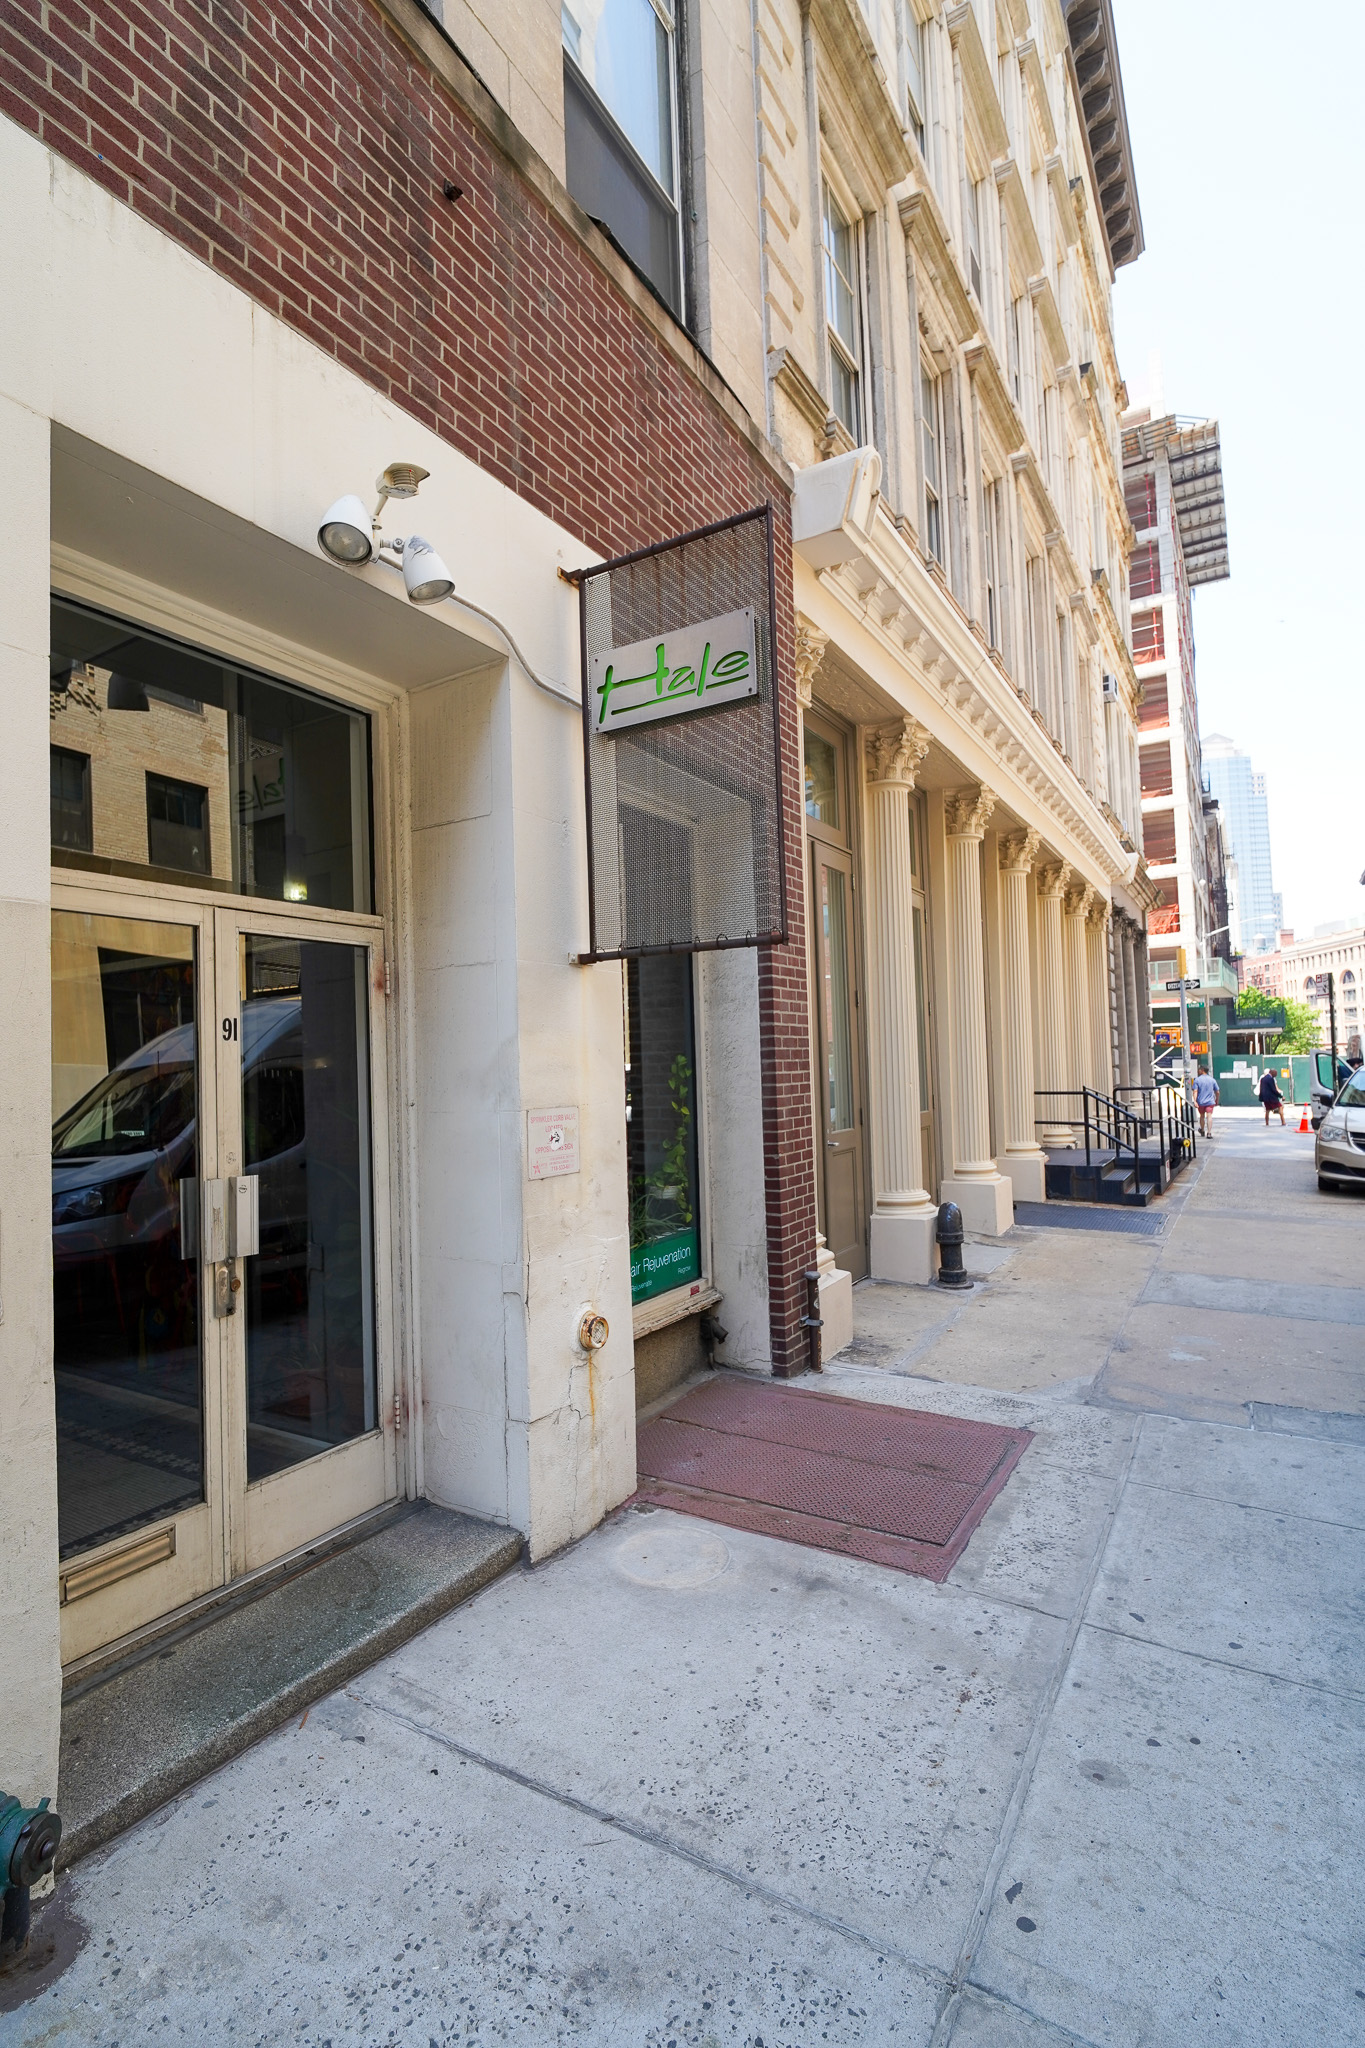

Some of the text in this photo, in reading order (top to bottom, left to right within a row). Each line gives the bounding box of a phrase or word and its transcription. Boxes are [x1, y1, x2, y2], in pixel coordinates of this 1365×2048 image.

[597, 643, 749, 724] Hale
[222, 1018, 237, 1041] 91
[643, 1247, 691, 1272] Rejuvenation
[678, 1266, 691, 1274] Regrow
